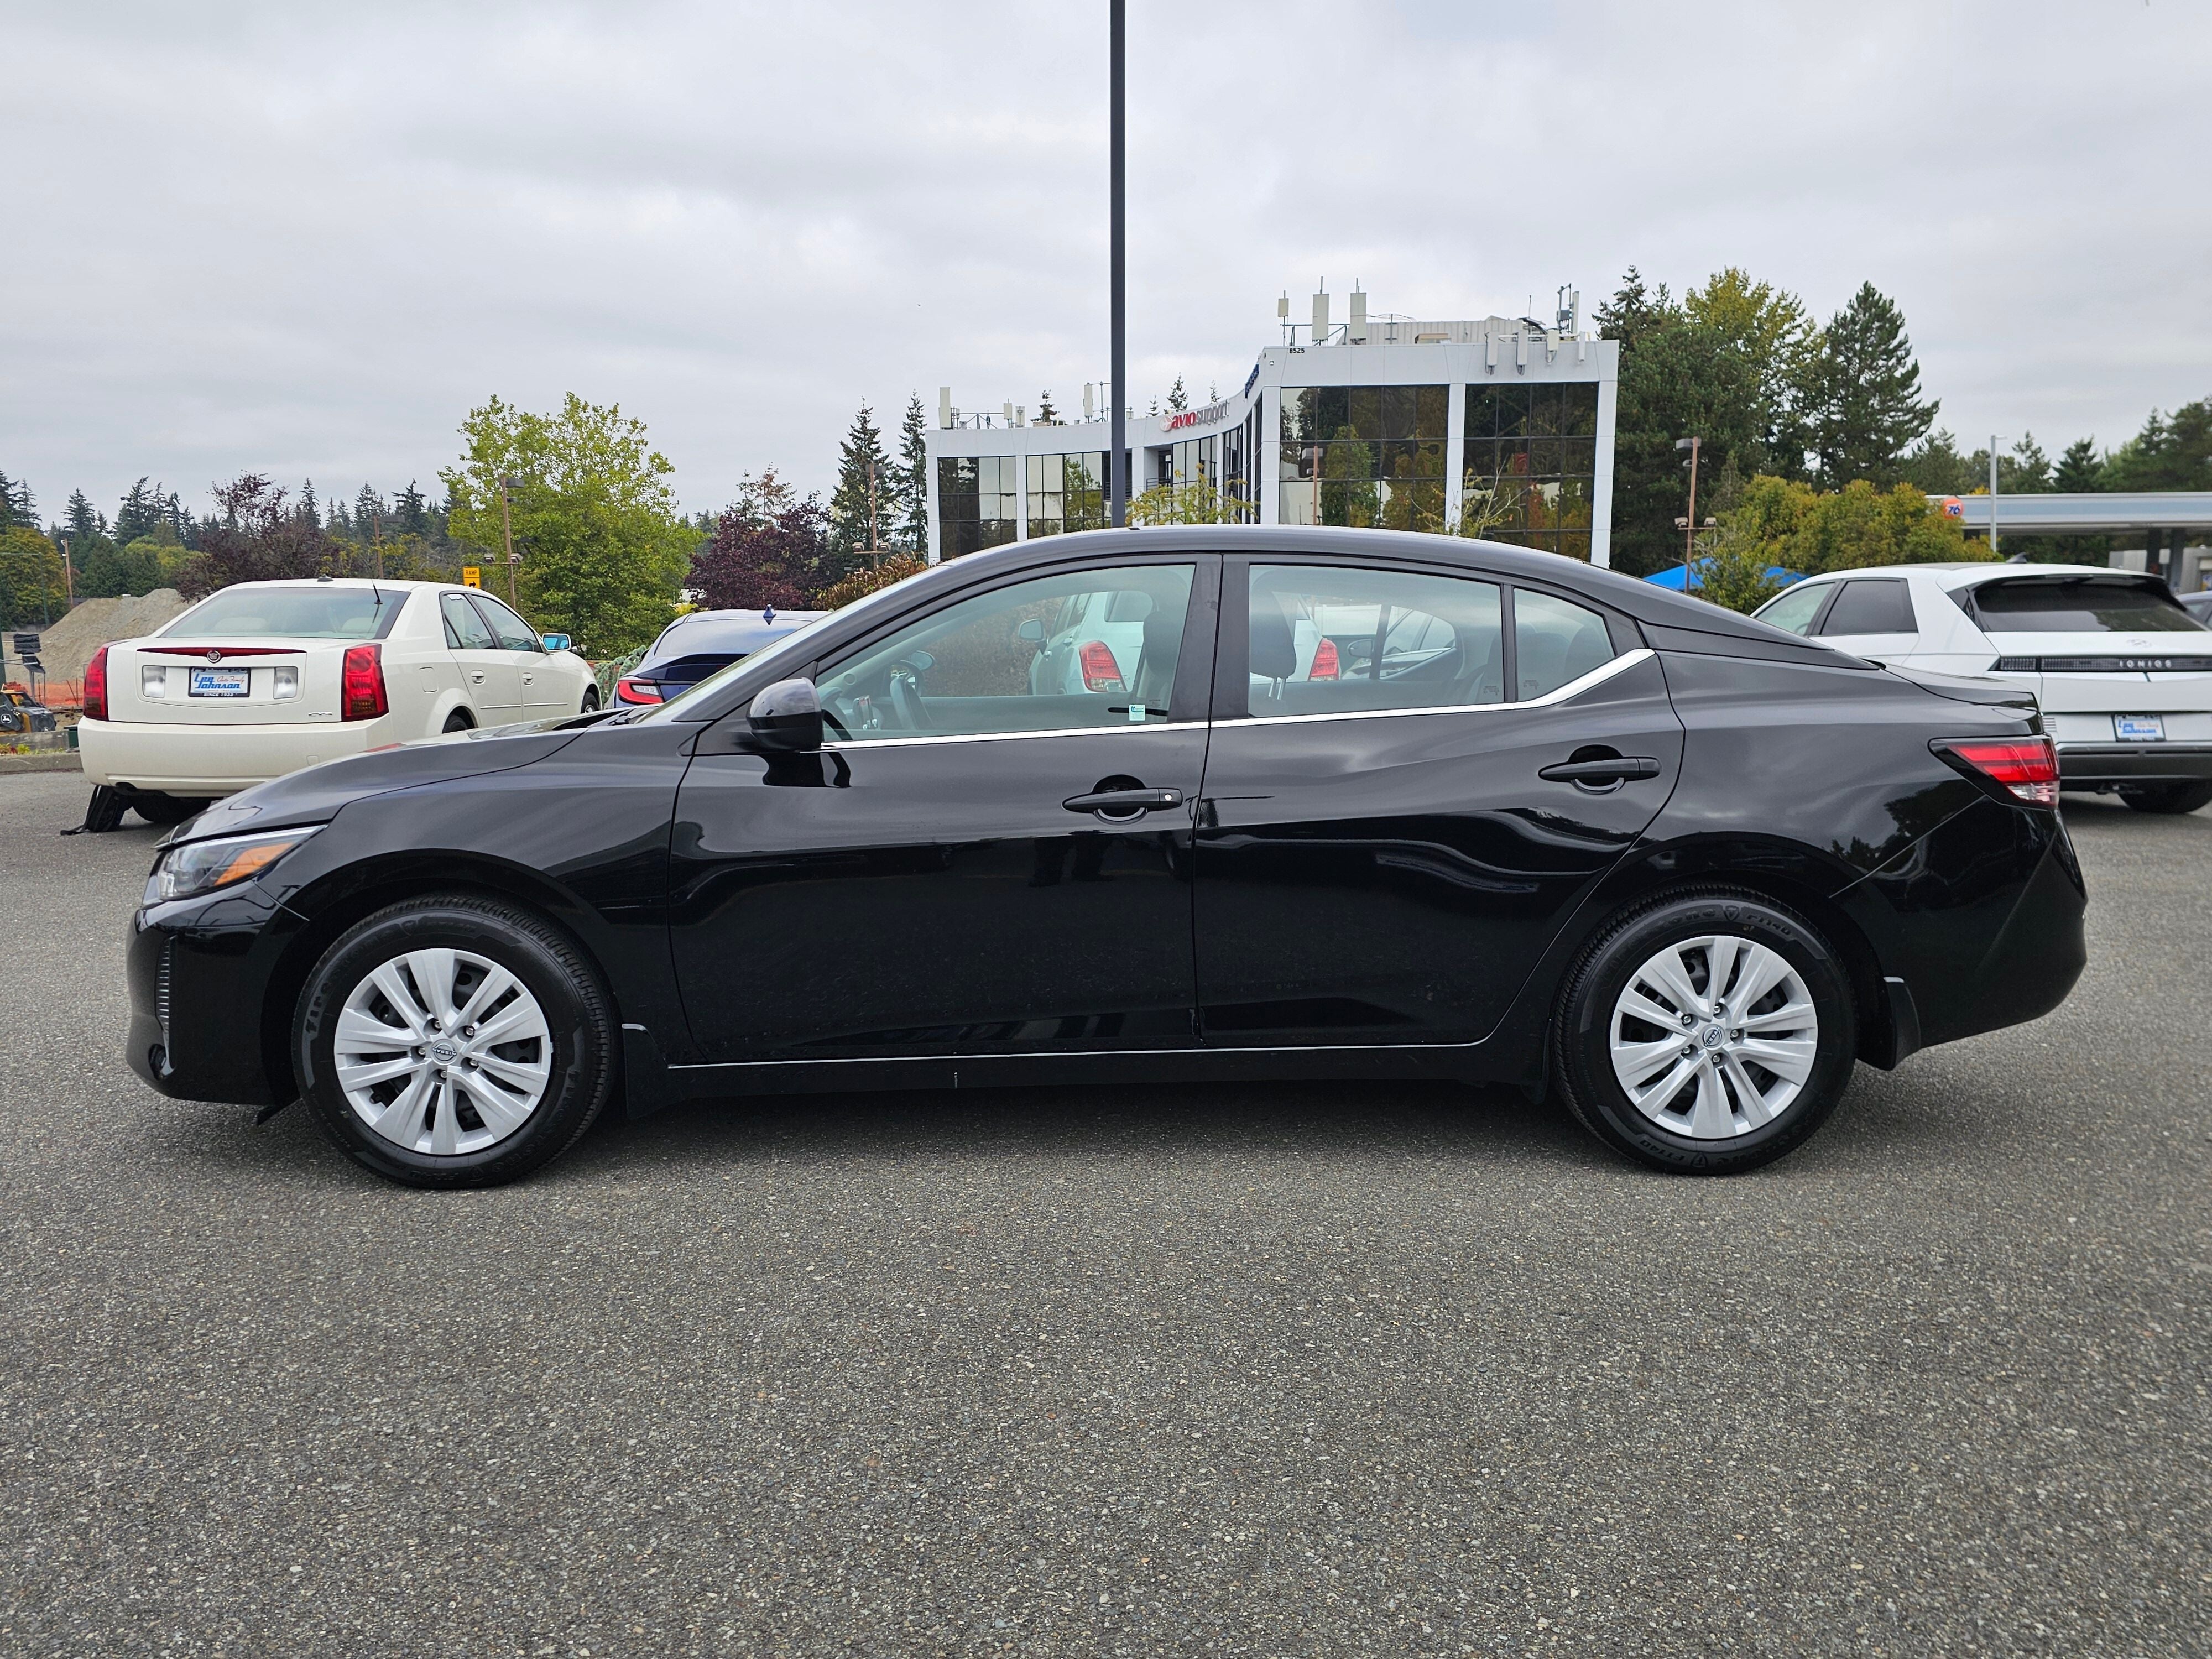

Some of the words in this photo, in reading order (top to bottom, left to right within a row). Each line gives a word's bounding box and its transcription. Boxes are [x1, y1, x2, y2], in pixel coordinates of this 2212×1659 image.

[1948, 504, 1960, 515] 76
[194, 673, 215, 682] Lee
[195, 680, 241, 689] Johnson
[432, 1048, 457, 1056] NISSAN
